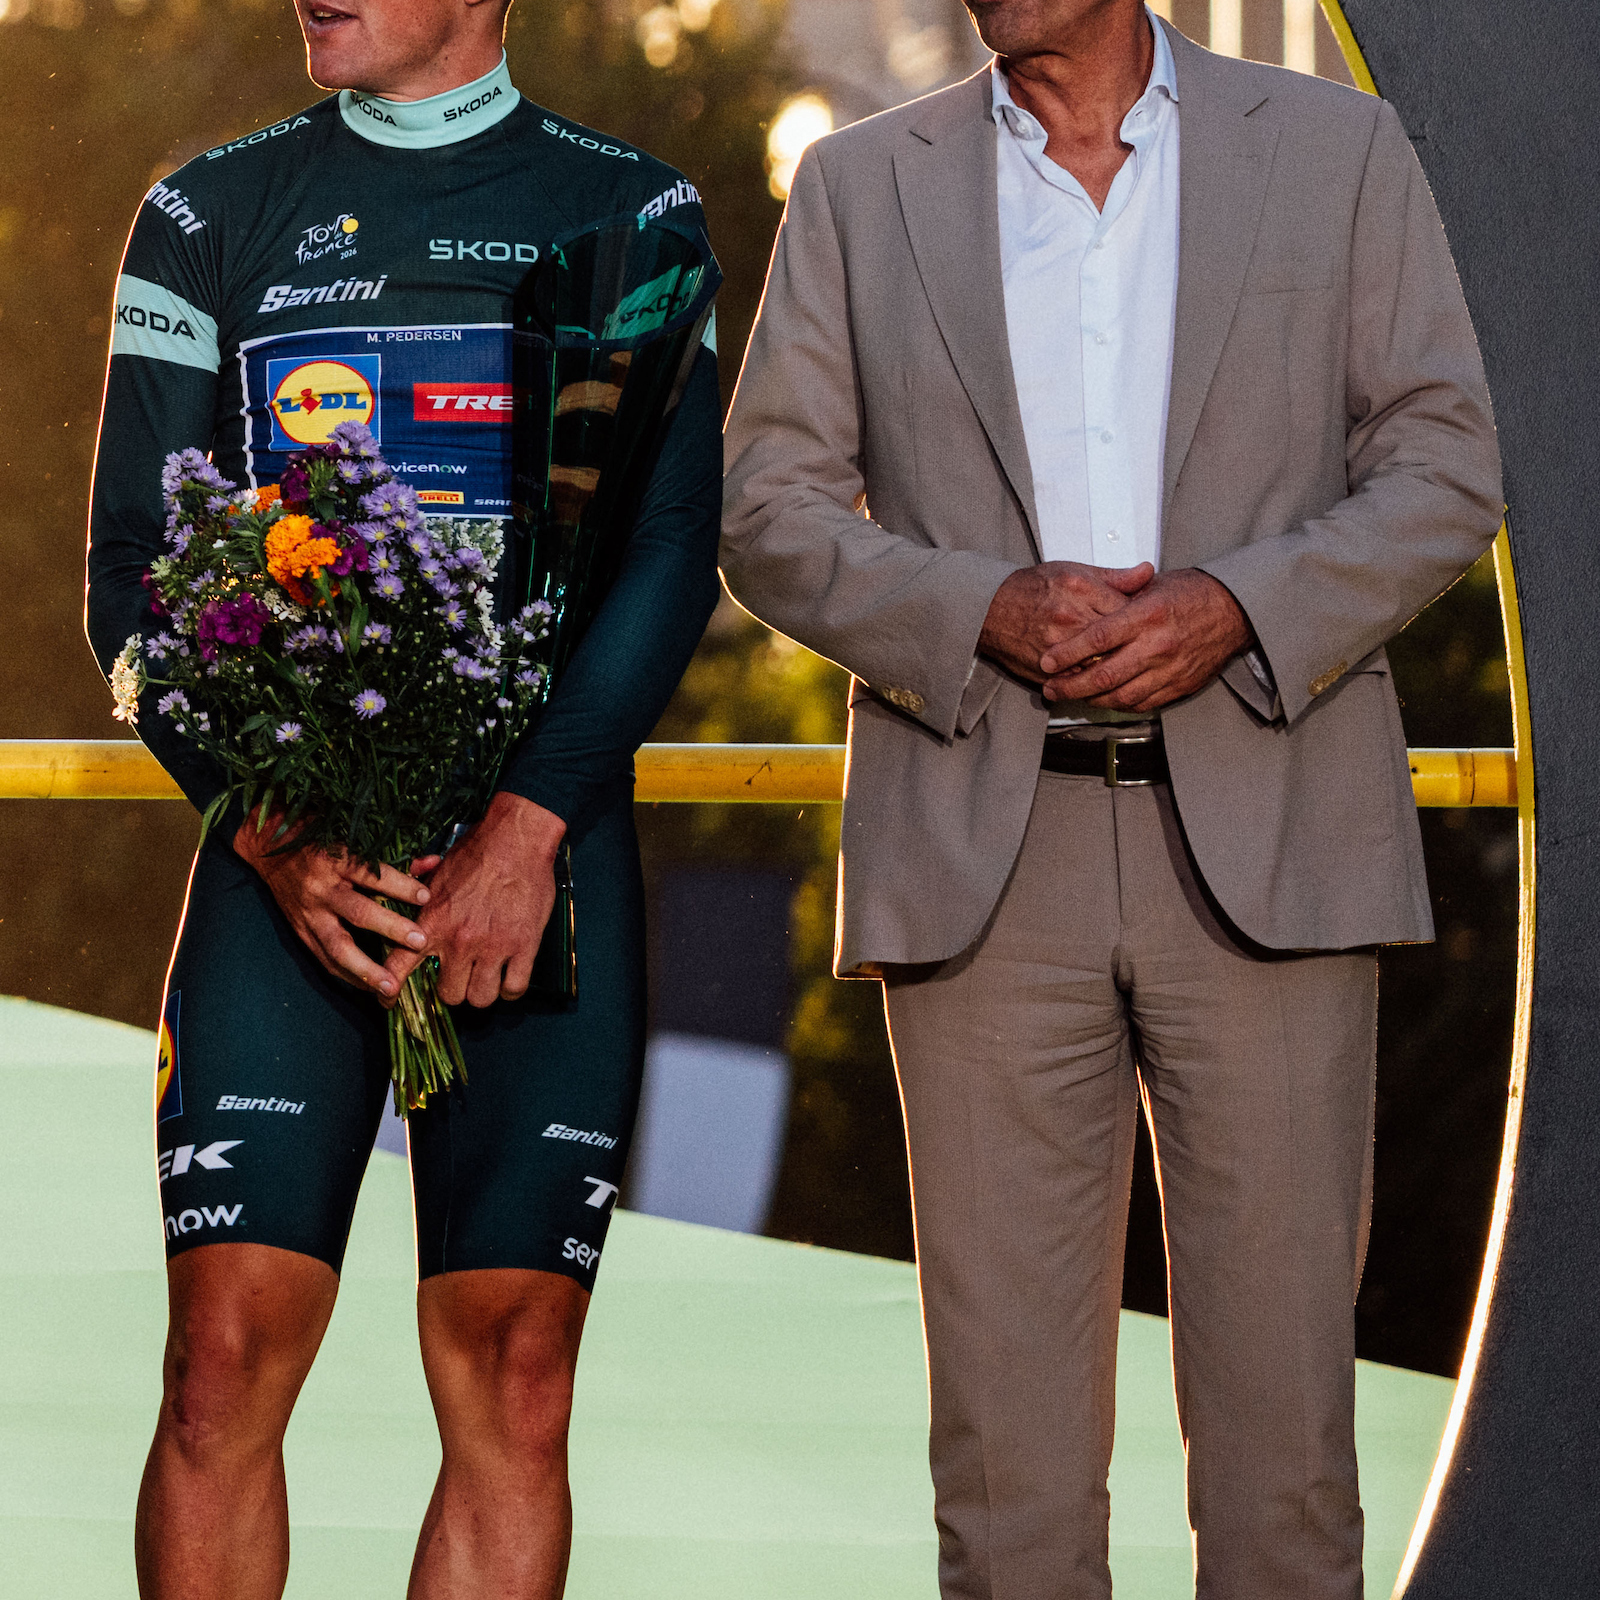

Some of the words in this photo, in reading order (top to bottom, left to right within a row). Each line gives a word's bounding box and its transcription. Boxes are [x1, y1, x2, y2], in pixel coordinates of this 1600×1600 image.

[301, 213, 353, 247] TOUR
[340, 247, 357, 260] 2026
[257, 274, 388, 314] Santini
[367, 332, 382, 343] M.
[386, 330, 462, 343] PEDERSEN
[426, 395, 513, 411] TRE
[388, 462, 467, 474] vicenow
[216, 1094, 306, 1114] Santini
[541, 1123, 619, 1150] Santini
[583, 1175, 619, 1215] T
